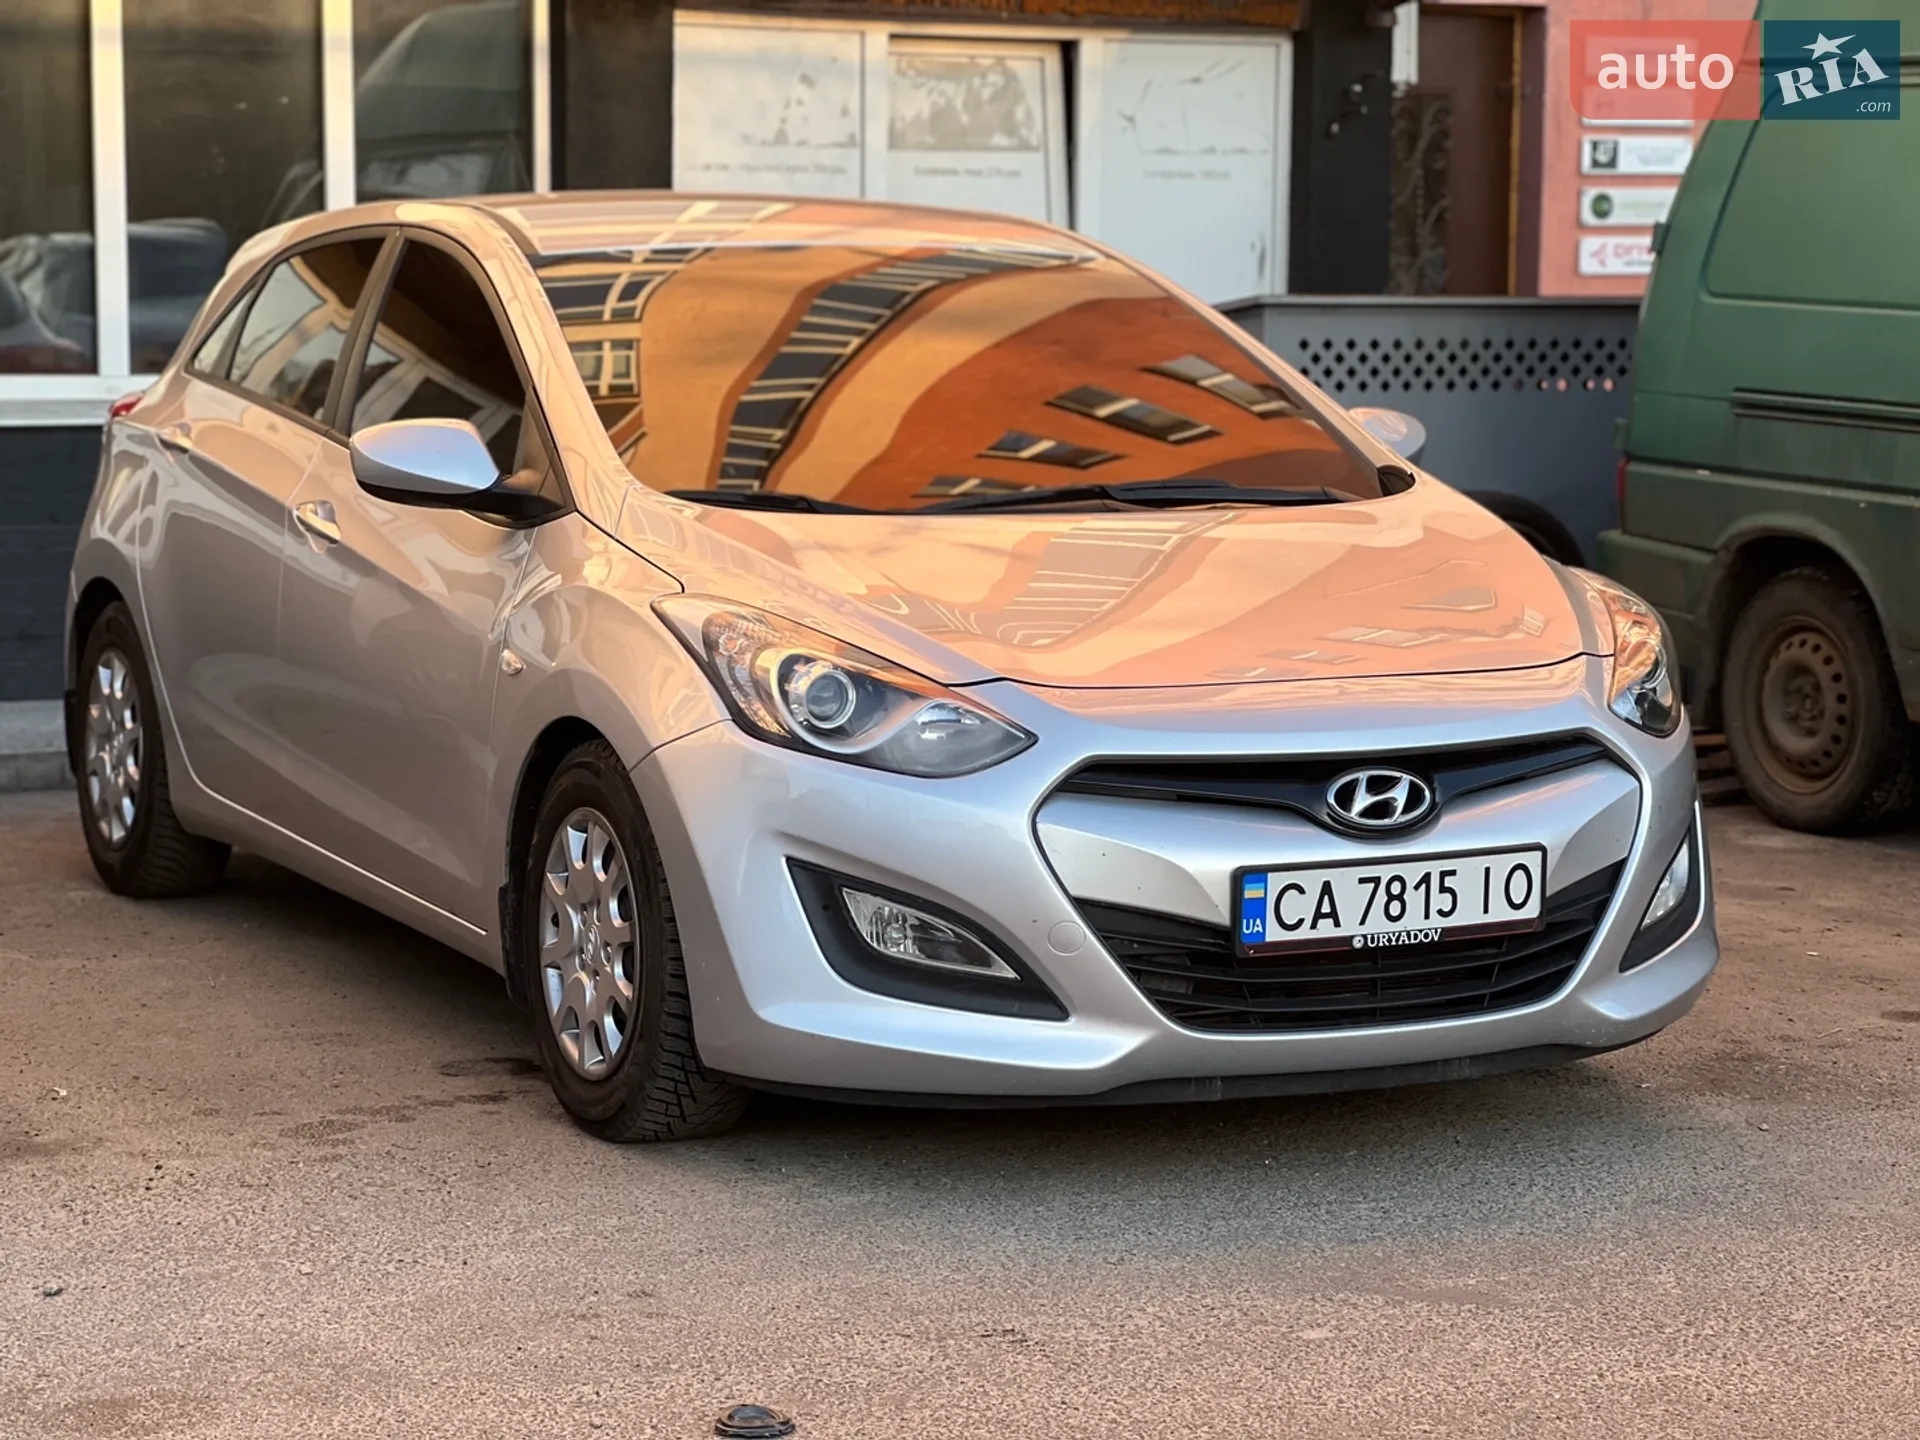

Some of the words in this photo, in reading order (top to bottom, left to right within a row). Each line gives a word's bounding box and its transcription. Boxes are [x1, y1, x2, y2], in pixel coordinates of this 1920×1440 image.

[1273, 880, 1341, 932] CA
[1357, 869, 1458, 926] 7815
[1483, 862, 1533, 915] IO
[1242, 918, 1264, 935] UA
[1366, 928, 1442, 947] URYADOV
